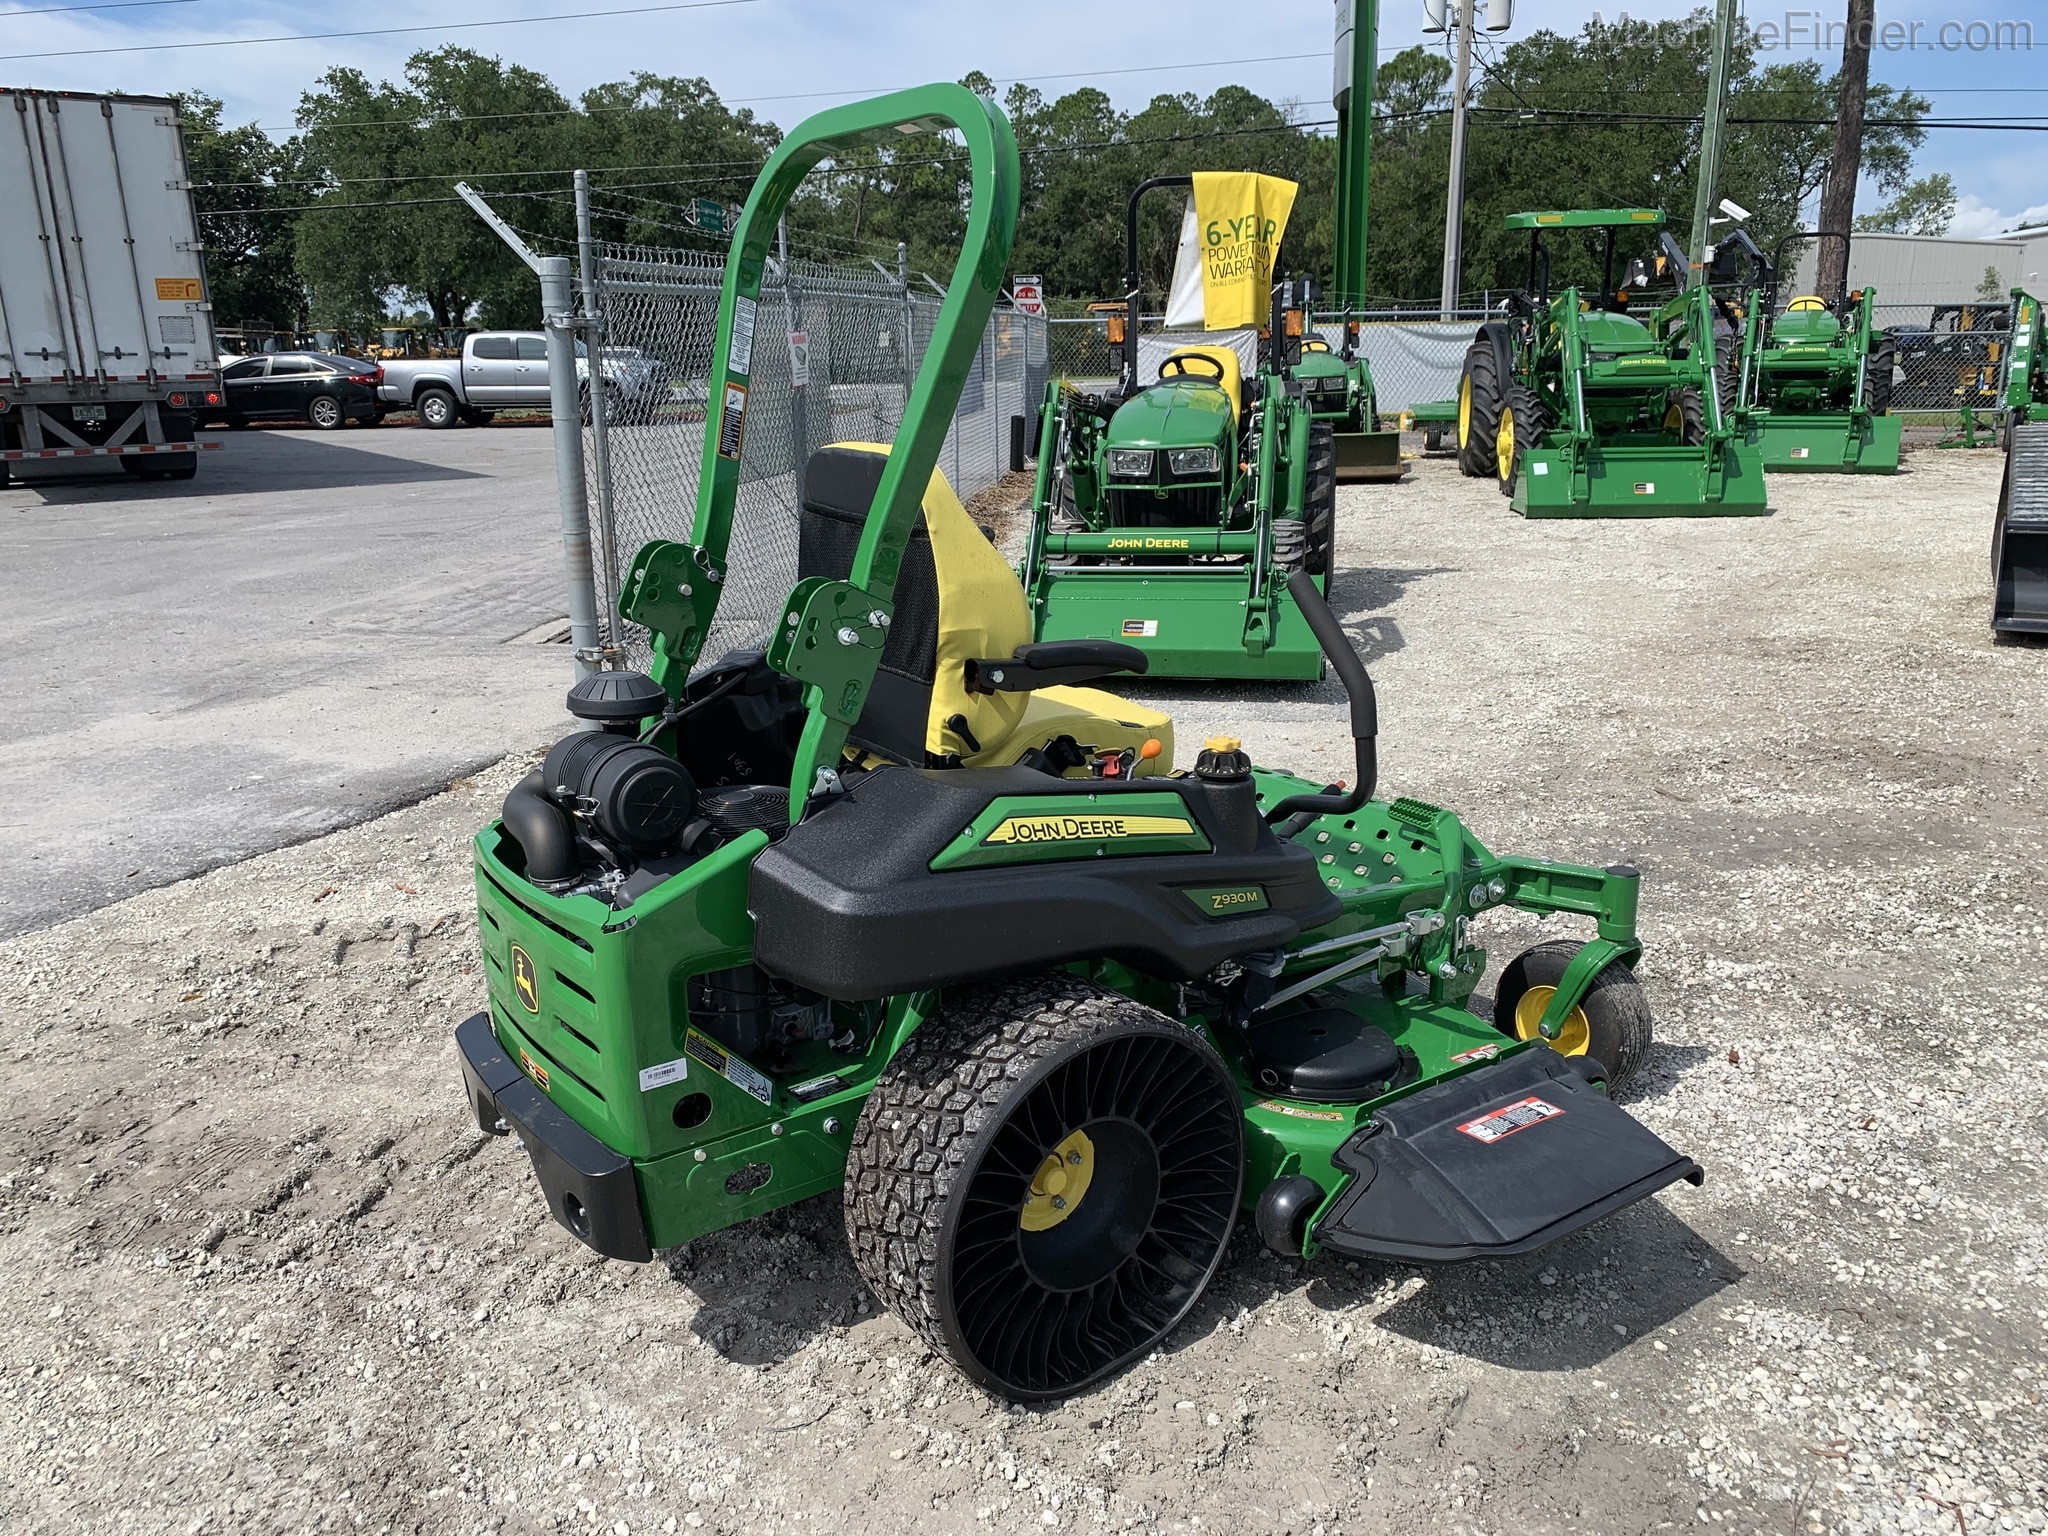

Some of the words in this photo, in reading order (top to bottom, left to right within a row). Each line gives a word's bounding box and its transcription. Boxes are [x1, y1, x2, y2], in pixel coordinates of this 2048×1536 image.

[1107, 537, 1143, 548] JOHN
[1145, 537, 1189, 548] DEERE
[1007, 821, 1061, 841] JOHN
[1062, 818, 1127, 838] DEERE
[1211, 891, 1258, 909] Z930M
